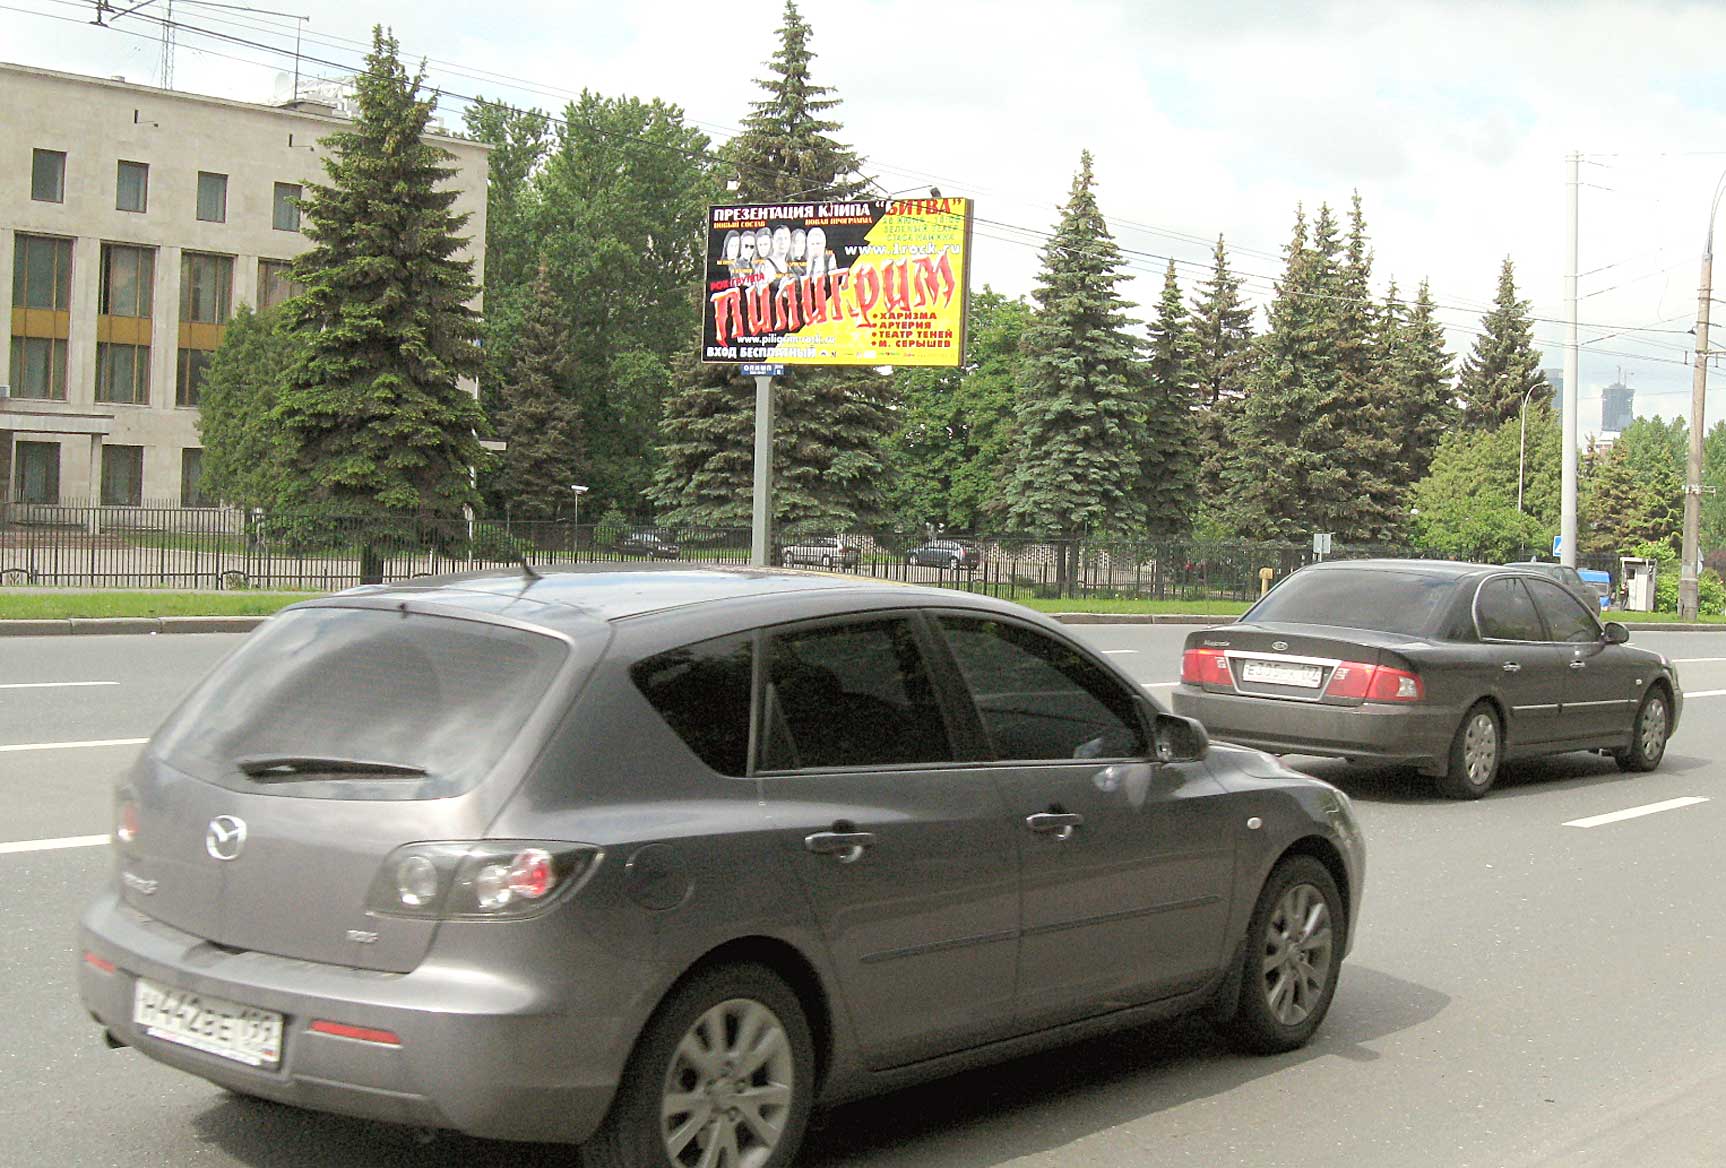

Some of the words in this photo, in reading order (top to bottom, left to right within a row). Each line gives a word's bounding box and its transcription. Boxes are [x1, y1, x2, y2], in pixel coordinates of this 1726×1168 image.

[714, 206, 814, 221] ПРЕЗЕНТАЦИЯ
[818, 203, 871, 218] КЛИПА
[844, 243, 961, 256] www.1rock.ru
[879, 312, 937, 320] ХАРИЗМА
[879, 321, 932, 329] АРТЕРИЯ
[878, 330, 913, 339] ТЕАТР
[917, 328, 953, 339] ТЕНЕЙ
[895, 340, 951, 348] СЕРЫШЕВ
[706, 346, 738, 359] ВХОД
[740, 345, 817, 359] БЕСПЛАТНЫЙ
